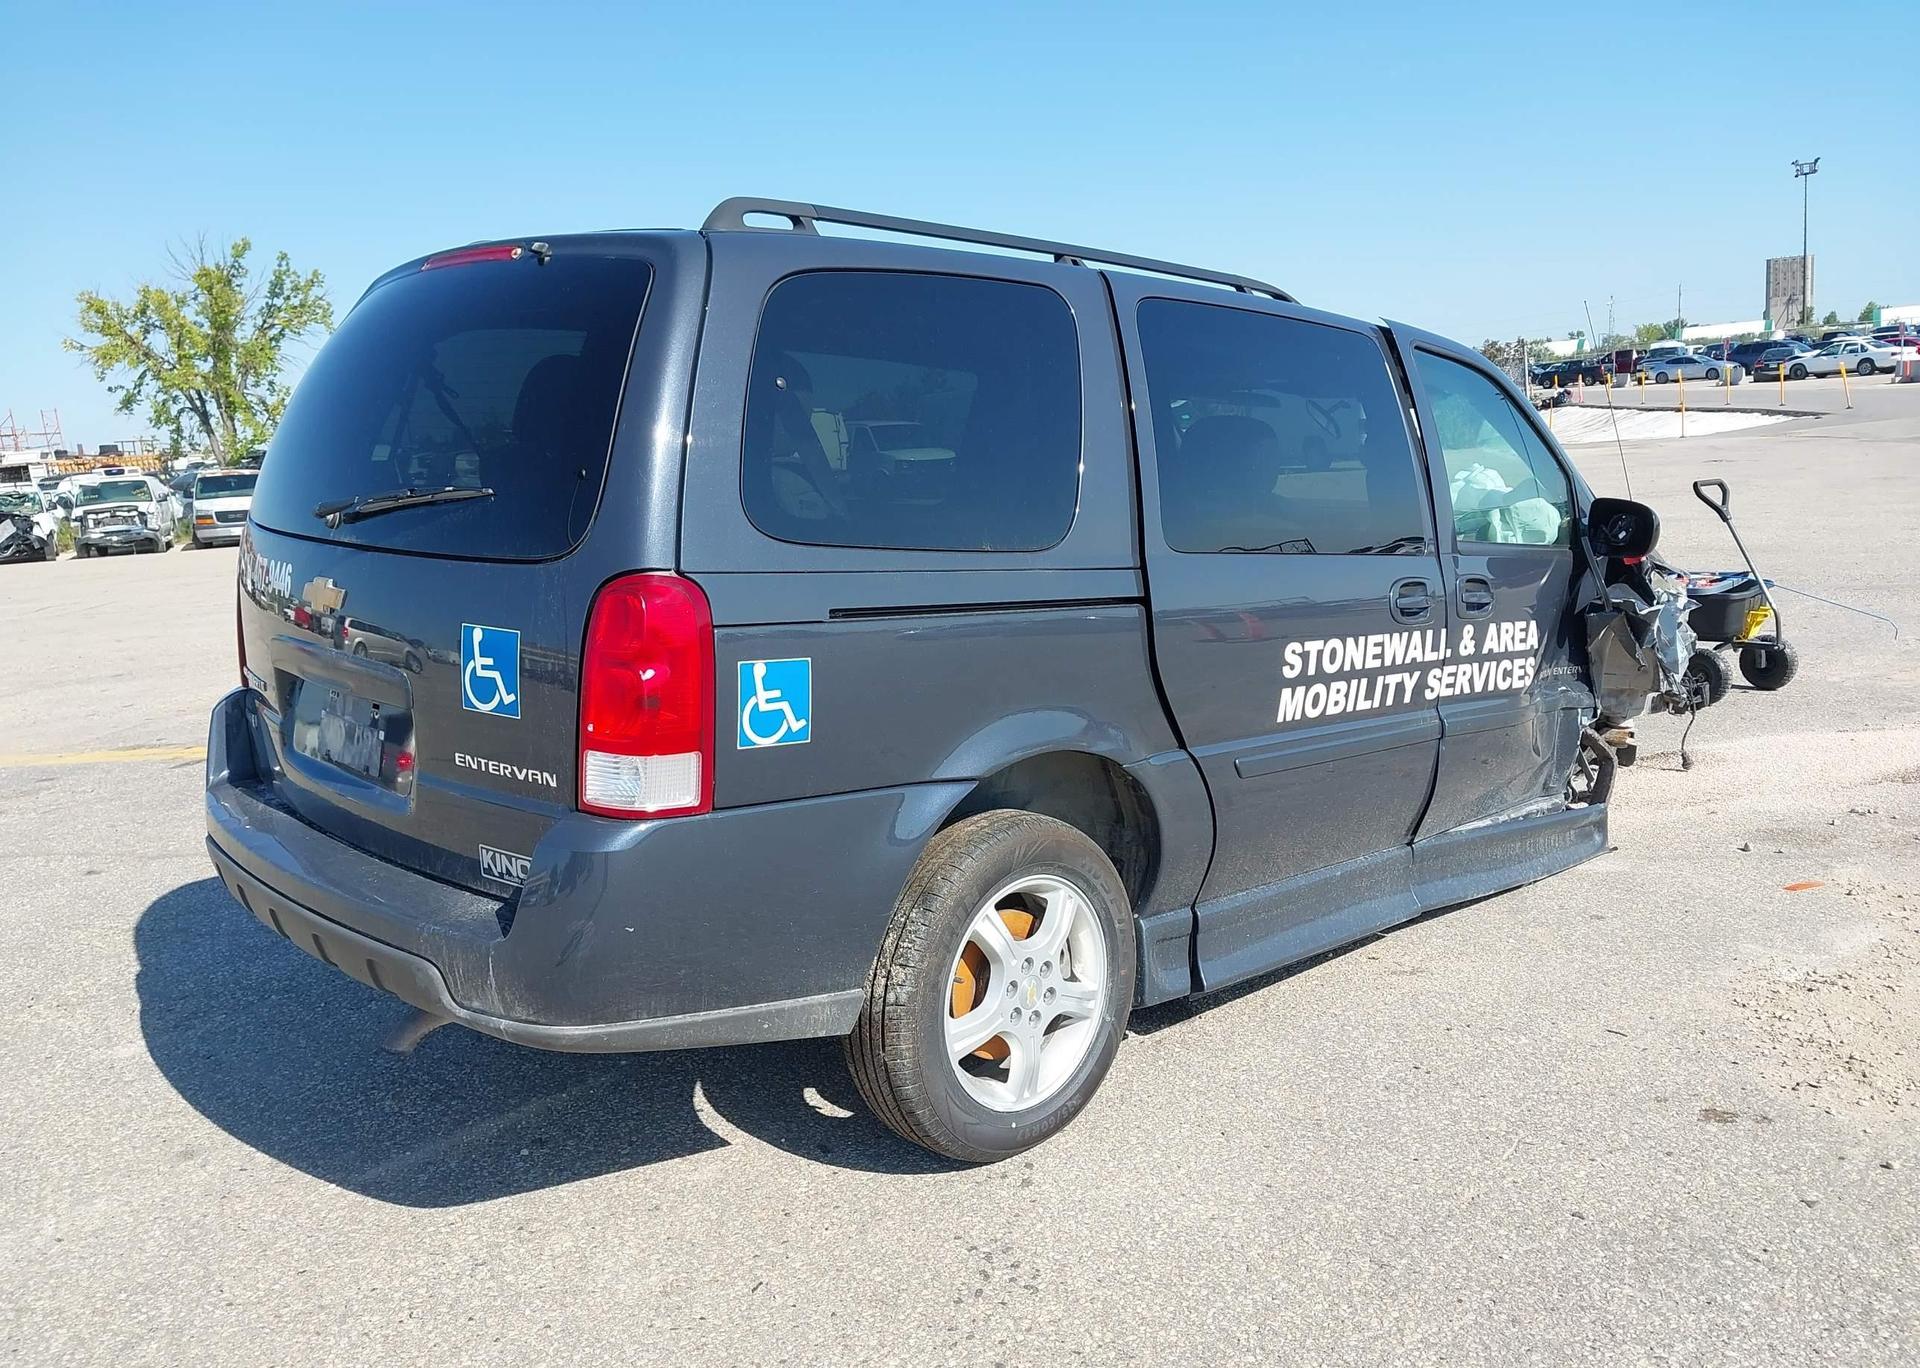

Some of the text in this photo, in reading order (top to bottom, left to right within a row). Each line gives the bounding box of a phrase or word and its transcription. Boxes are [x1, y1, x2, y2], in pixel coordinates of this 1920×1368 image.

[1282, 620, 1538, 678] STONEWALL & AREA
[1276, 656, 1536, 723] MOBILITY SERVICES
[454, 752, 558, 788] ENTERVAN
